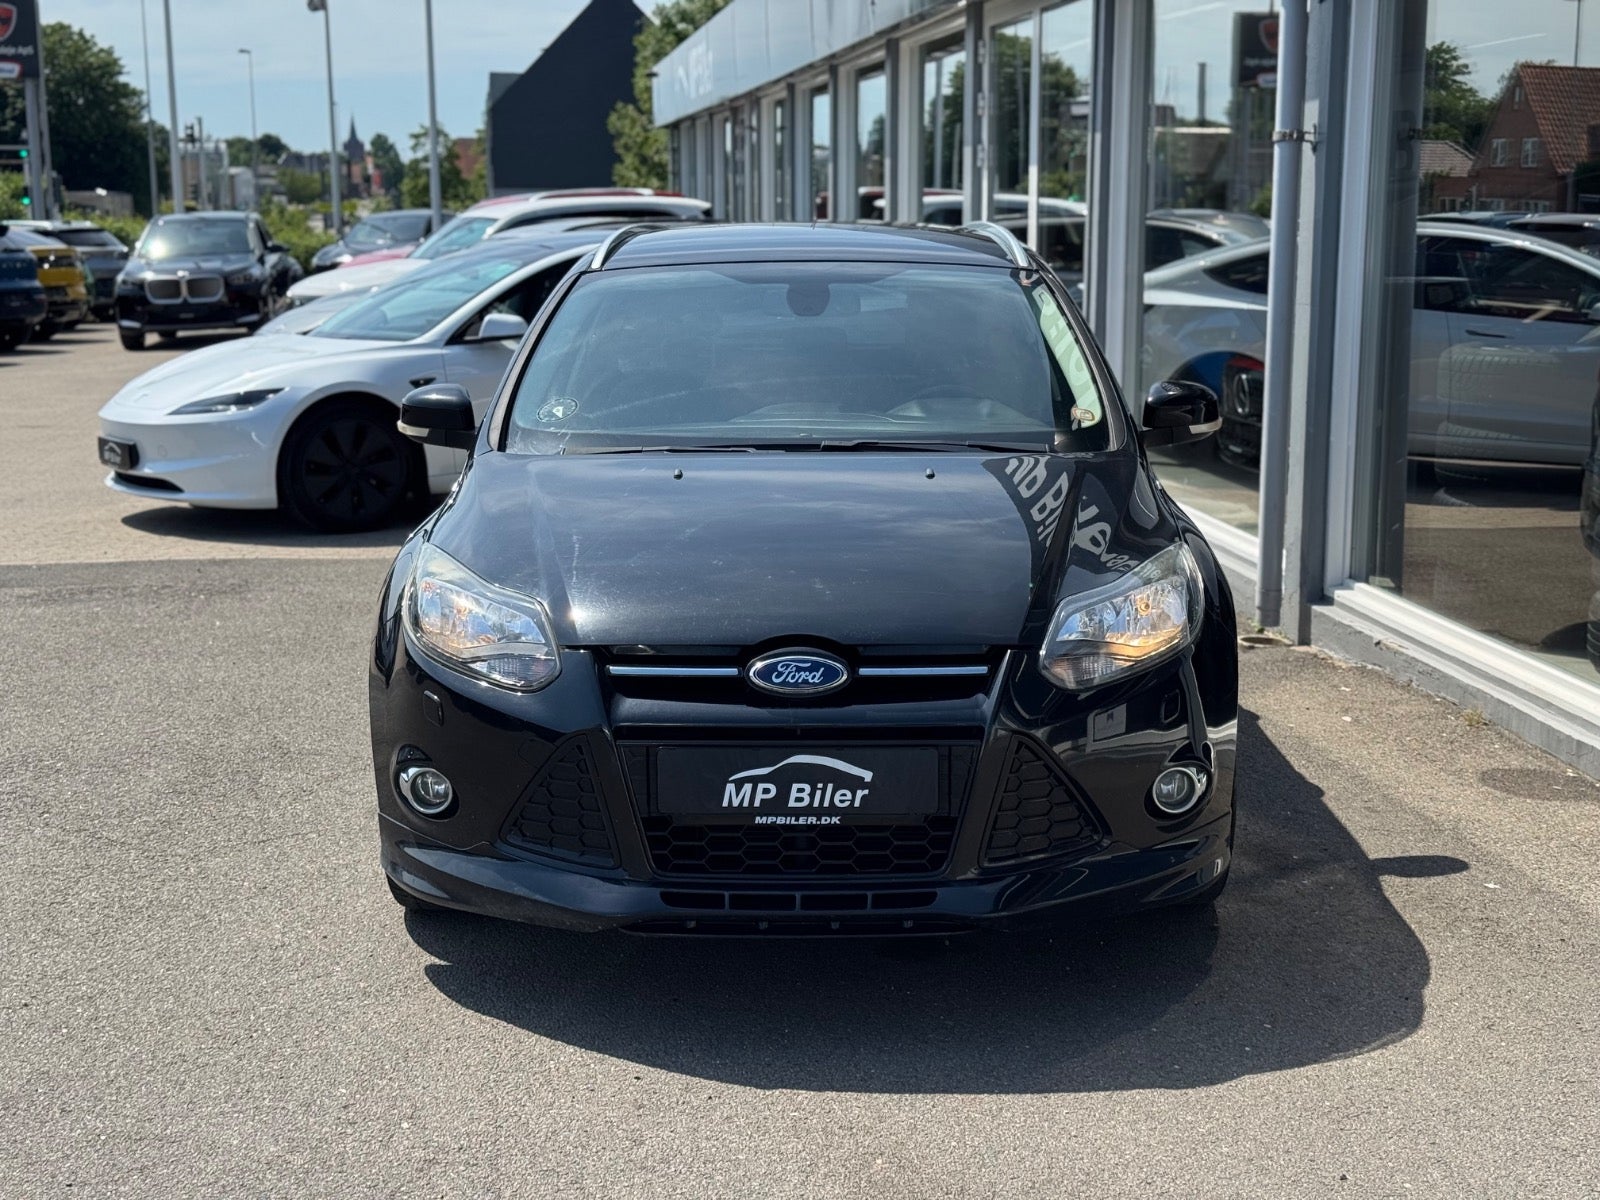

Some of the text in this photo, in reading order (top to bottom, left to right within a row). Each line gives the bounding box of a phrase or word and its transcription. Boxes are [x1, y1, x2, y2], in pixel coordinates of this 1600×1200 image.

[771, 661, 825, 683] Ford
[721, 783, 869, 808] MP Biler
[754, 816, 841, 825] MPBILER.DK
